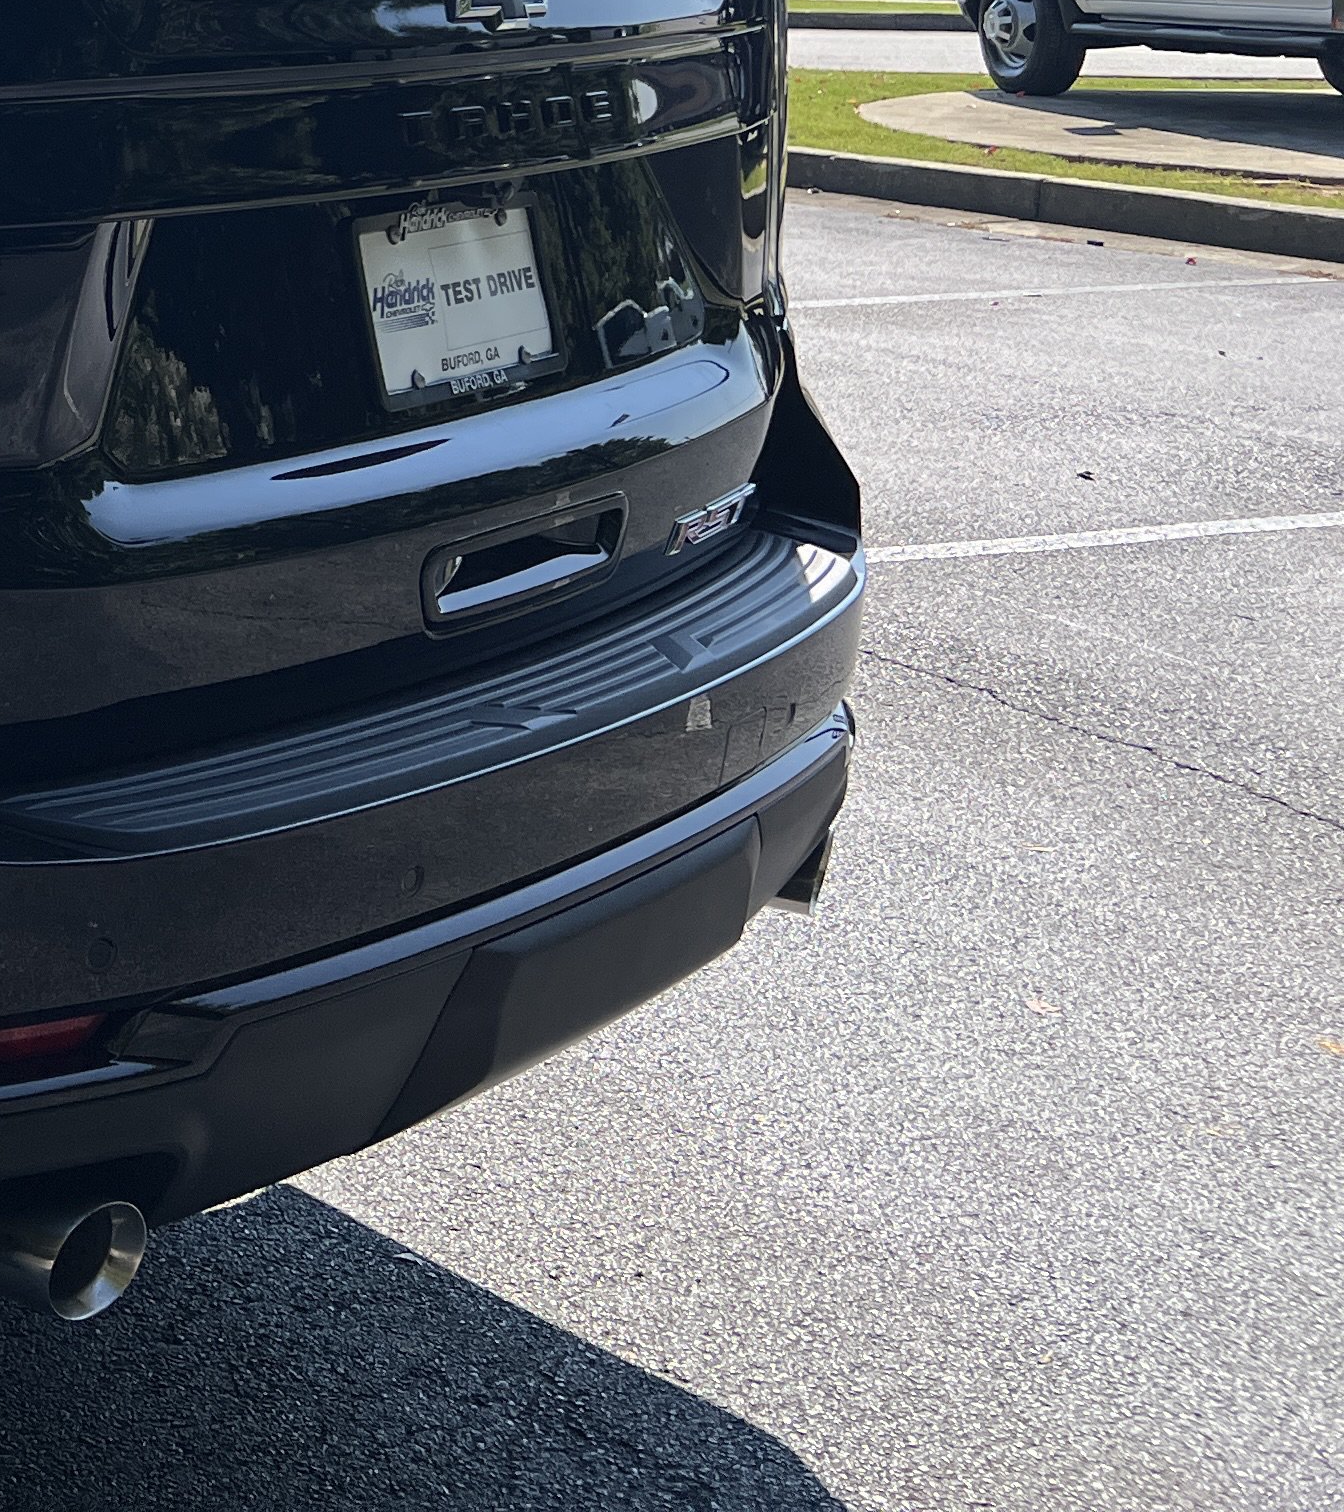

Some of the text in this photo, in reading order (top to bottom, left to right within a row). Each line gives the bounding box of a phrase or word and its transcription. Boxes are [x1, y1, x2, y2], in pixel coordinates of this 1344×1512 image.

[396, 89, 614, 145] TAHOE
[399, 207, 449, 241] Hendrick
[372, 278, 435, 319] Hendrick
[440, 266, 536, 307] TEST DRIVE
[441, 346, 501, 372] BUFORD, GA
[450, 369, 509, 395] BUFORD, GA
[663, 481, 757, 557] RST
